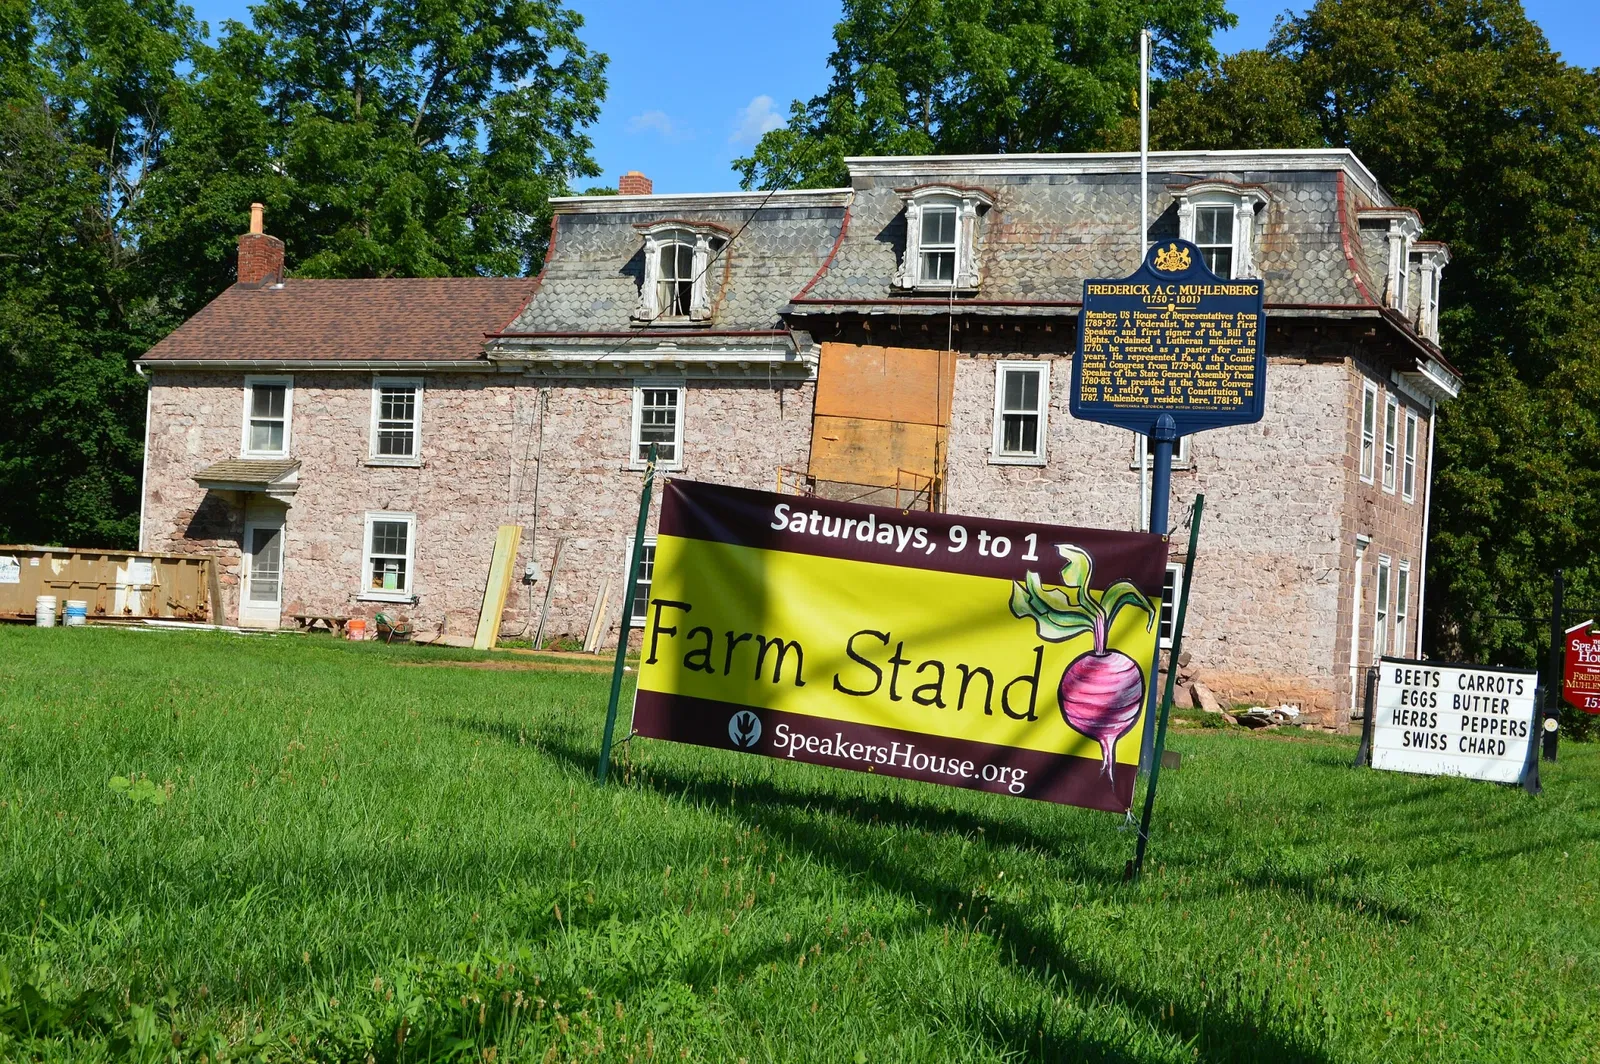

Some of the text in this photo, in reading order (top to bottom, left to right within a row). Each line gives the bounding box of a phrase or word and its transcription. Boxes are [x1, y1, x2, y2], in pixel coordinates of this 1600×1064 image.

[1088, 285, 1258, 296] FREDERICK A.C. MUHLENBERG
[1086, 311, 1118, 319] Member,
[1172, 312, 1233, 322] Representatives
[1085, 328, 1117, 336] Speaker
[1165, 329, 1191, 338] signer
[1186, 346, 1211, 354] pastor
[1128, 354, 1176, 362] represented
[1110, 362, 1144, 370] Congress
[1082, 370, 1111, 378] Speaker
[1194, 371, 1231, 380] Assembly
[1131, 378, 1164, 388] presided
[1119, 386, 1144, 395] ratify
[1188, 388, 1238, 396] Constitution
[1103, 394, 1148, 404] Muhlenberg
[1189, 395, 1210, 404] here,
[770, 503, 1039, 562] Saturdays, 9 to 1
[645, 598, 1044, 722] Farm Stand
[1395, 668, 1523, 695] BEETS CARROTS
[1401, 690, 1509, 715] EGGS BUTTER
[1392, 709, 1527, 737] HERBS PEPPERS
[1403, 730, 1506, 756] SWISS CHARD
[773, 723, 1028, 795] SpeakersHouse.org
